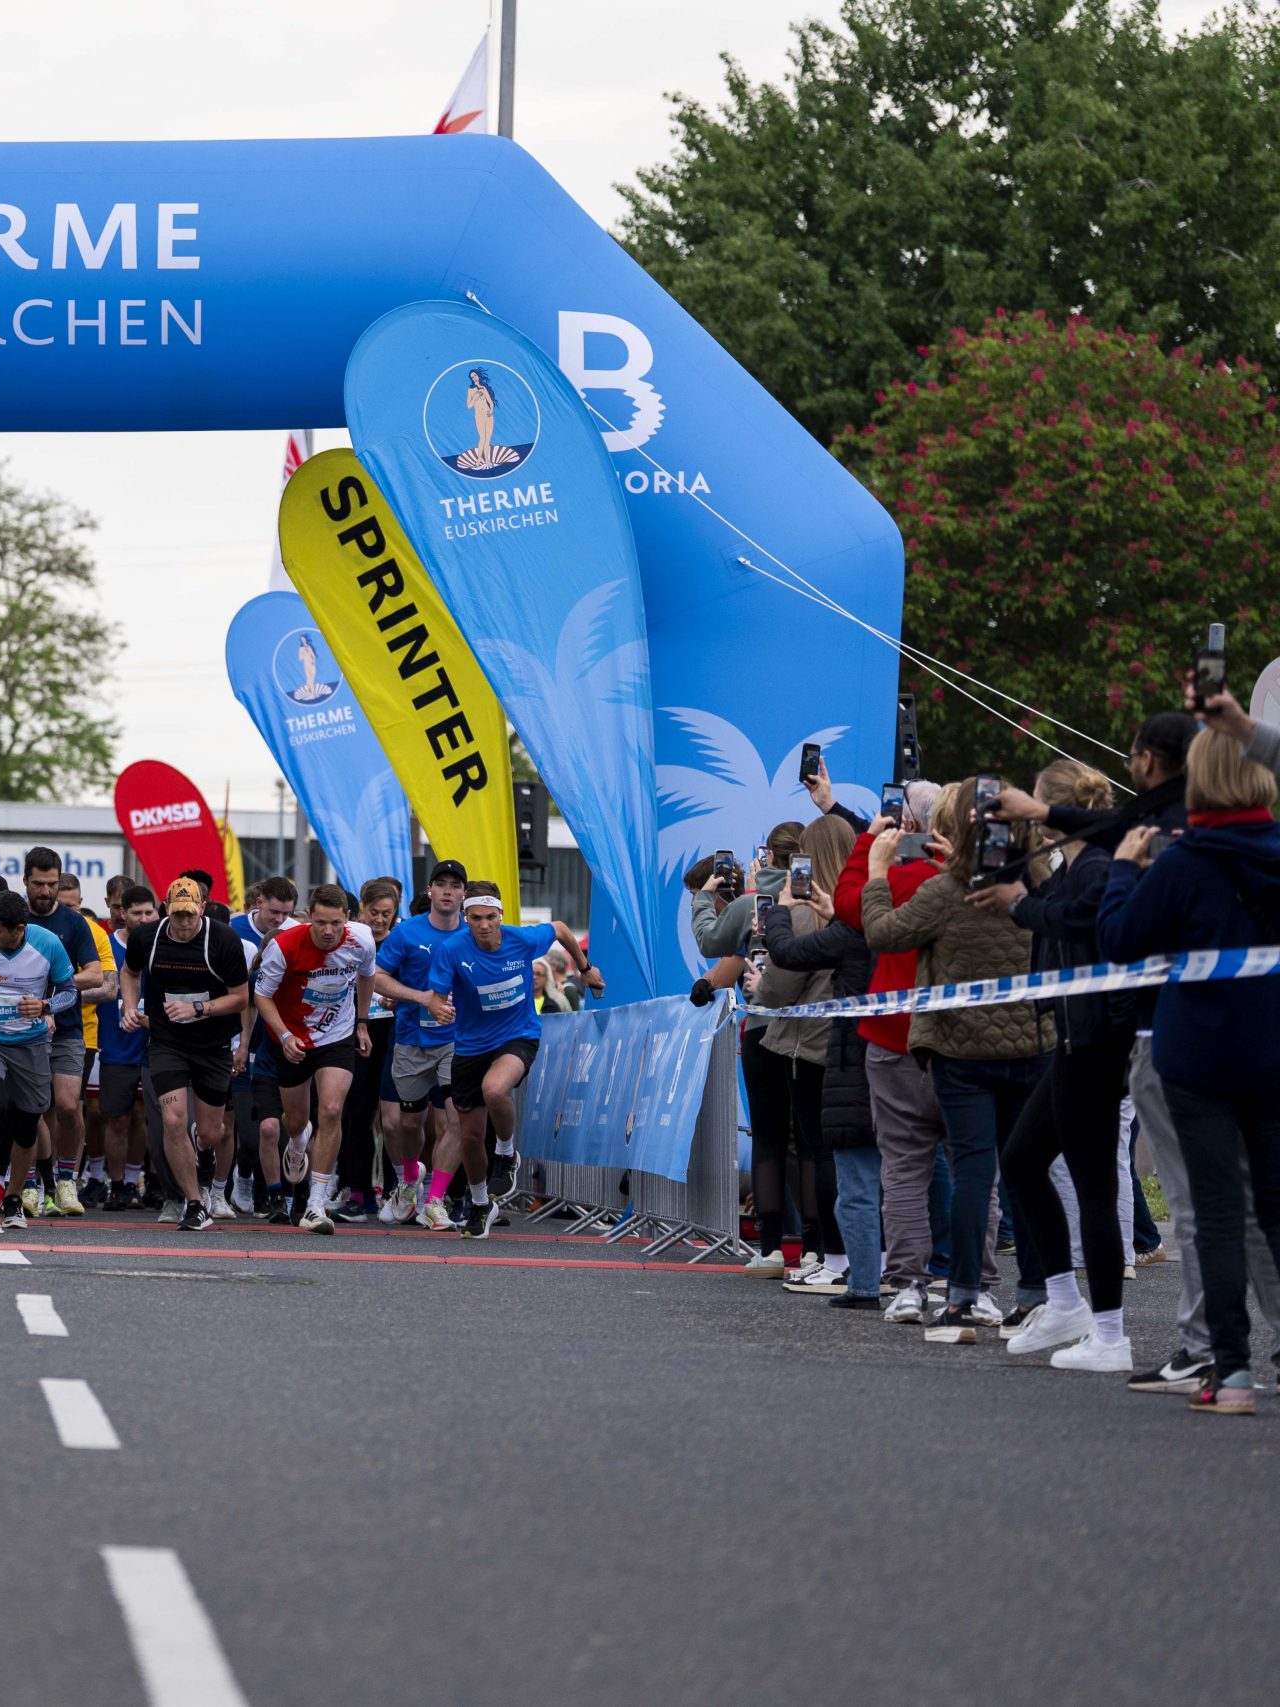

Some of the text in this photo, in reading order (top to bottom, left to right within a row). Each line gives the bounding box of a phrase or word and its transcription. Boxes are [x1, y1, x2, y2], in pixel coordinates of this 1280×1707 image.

[558, 310, 665, 453] B
[616, 470, 712, 494] ORIA
[439, 482, 555, 519] THERME
[444, 508, 559, 540] EUSKIRCHEN
[320, 474, 488, 808] SPRINTER
[285, 705, 353, 733] THERME
[288, 722, 357, 747] EUSKIRCHEN
